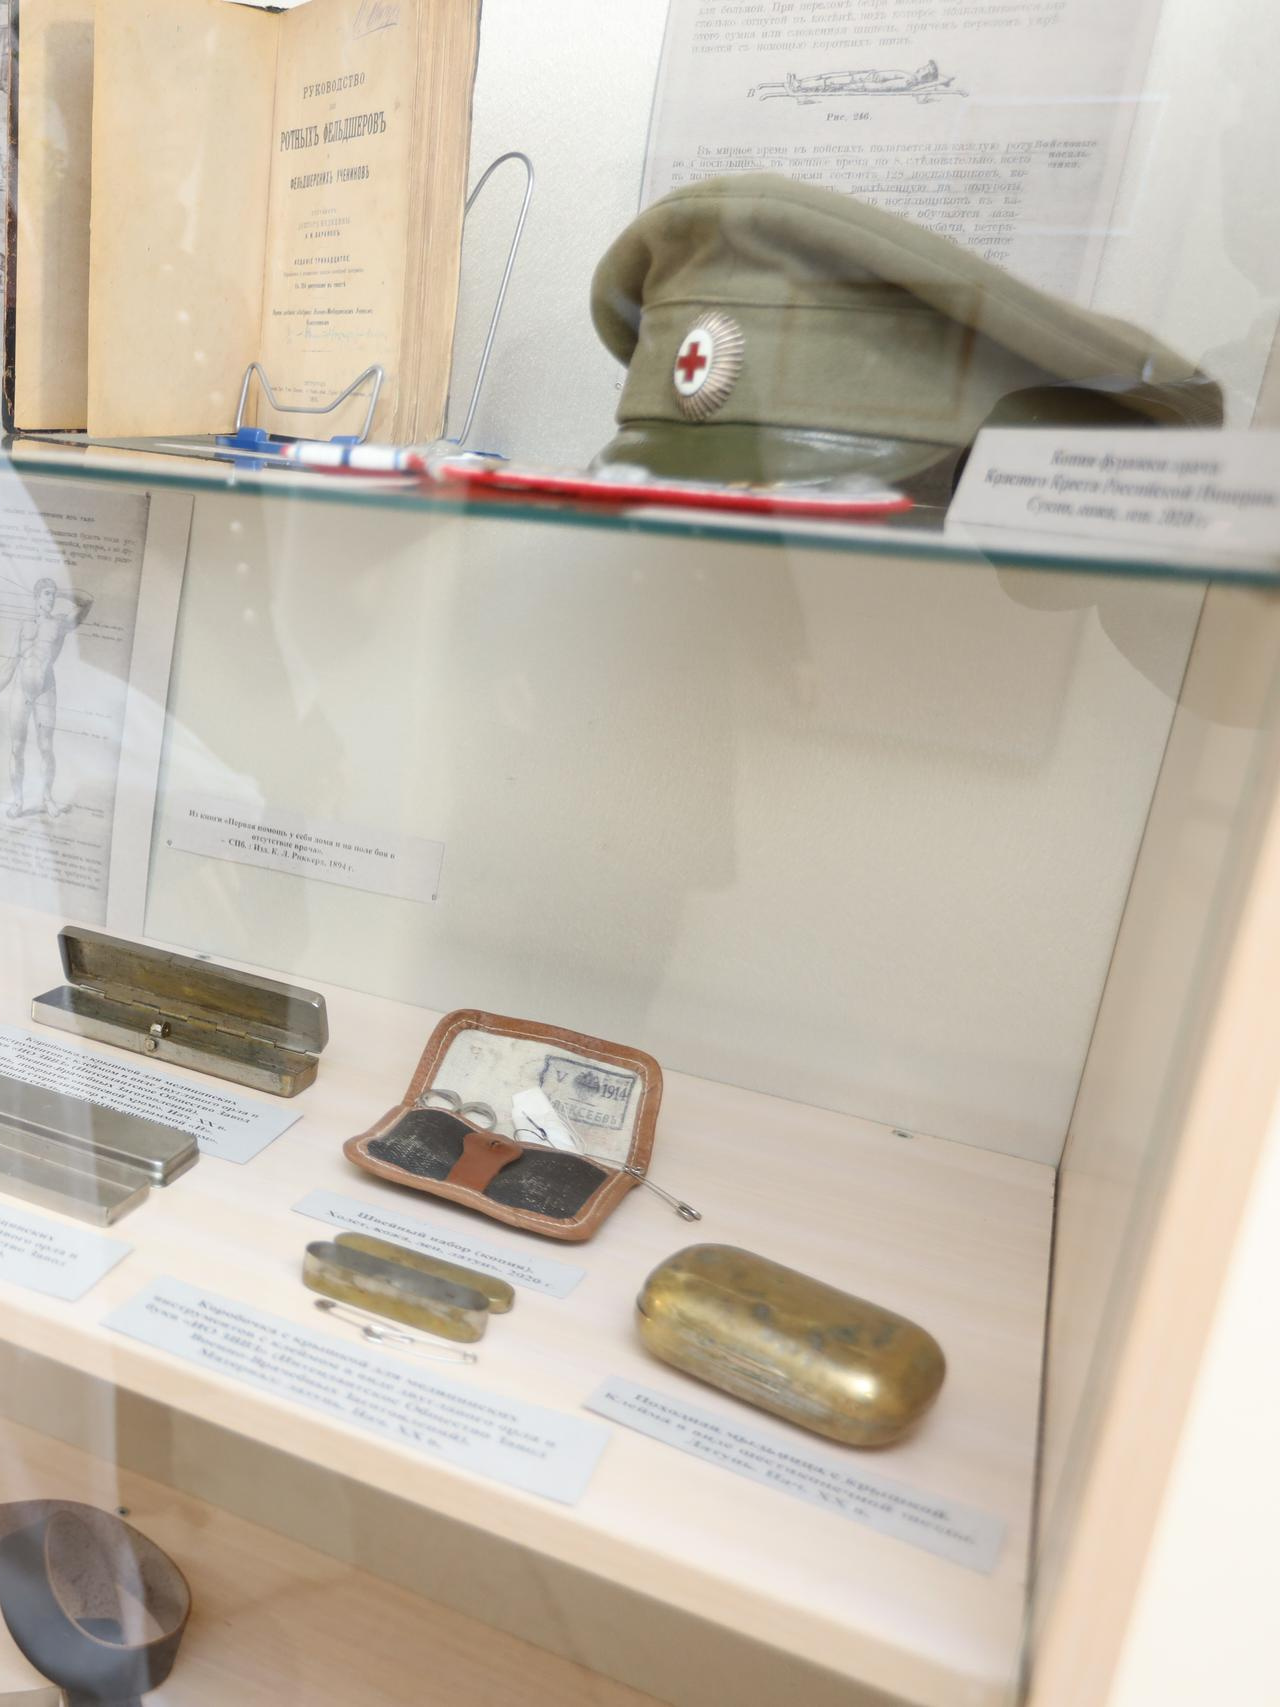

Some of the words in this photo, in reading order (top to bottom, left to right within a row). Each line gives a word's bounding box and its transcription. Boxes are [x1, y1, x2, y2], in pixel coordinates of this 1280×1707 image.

[302, 71, 366, 100] РУКОВОДСТВО
[279, 125, 320, 153] РОТНЫХЪ
[322, 110, 387, 145] ФЕЛЬДШЕРОВЪ
[556, 1070, 569, 1083] V
[601, 1083, 629, 1100] 1914
[356, 1211, 427, 1238] Швейный
[428, 1235, 472, 1253] набор
